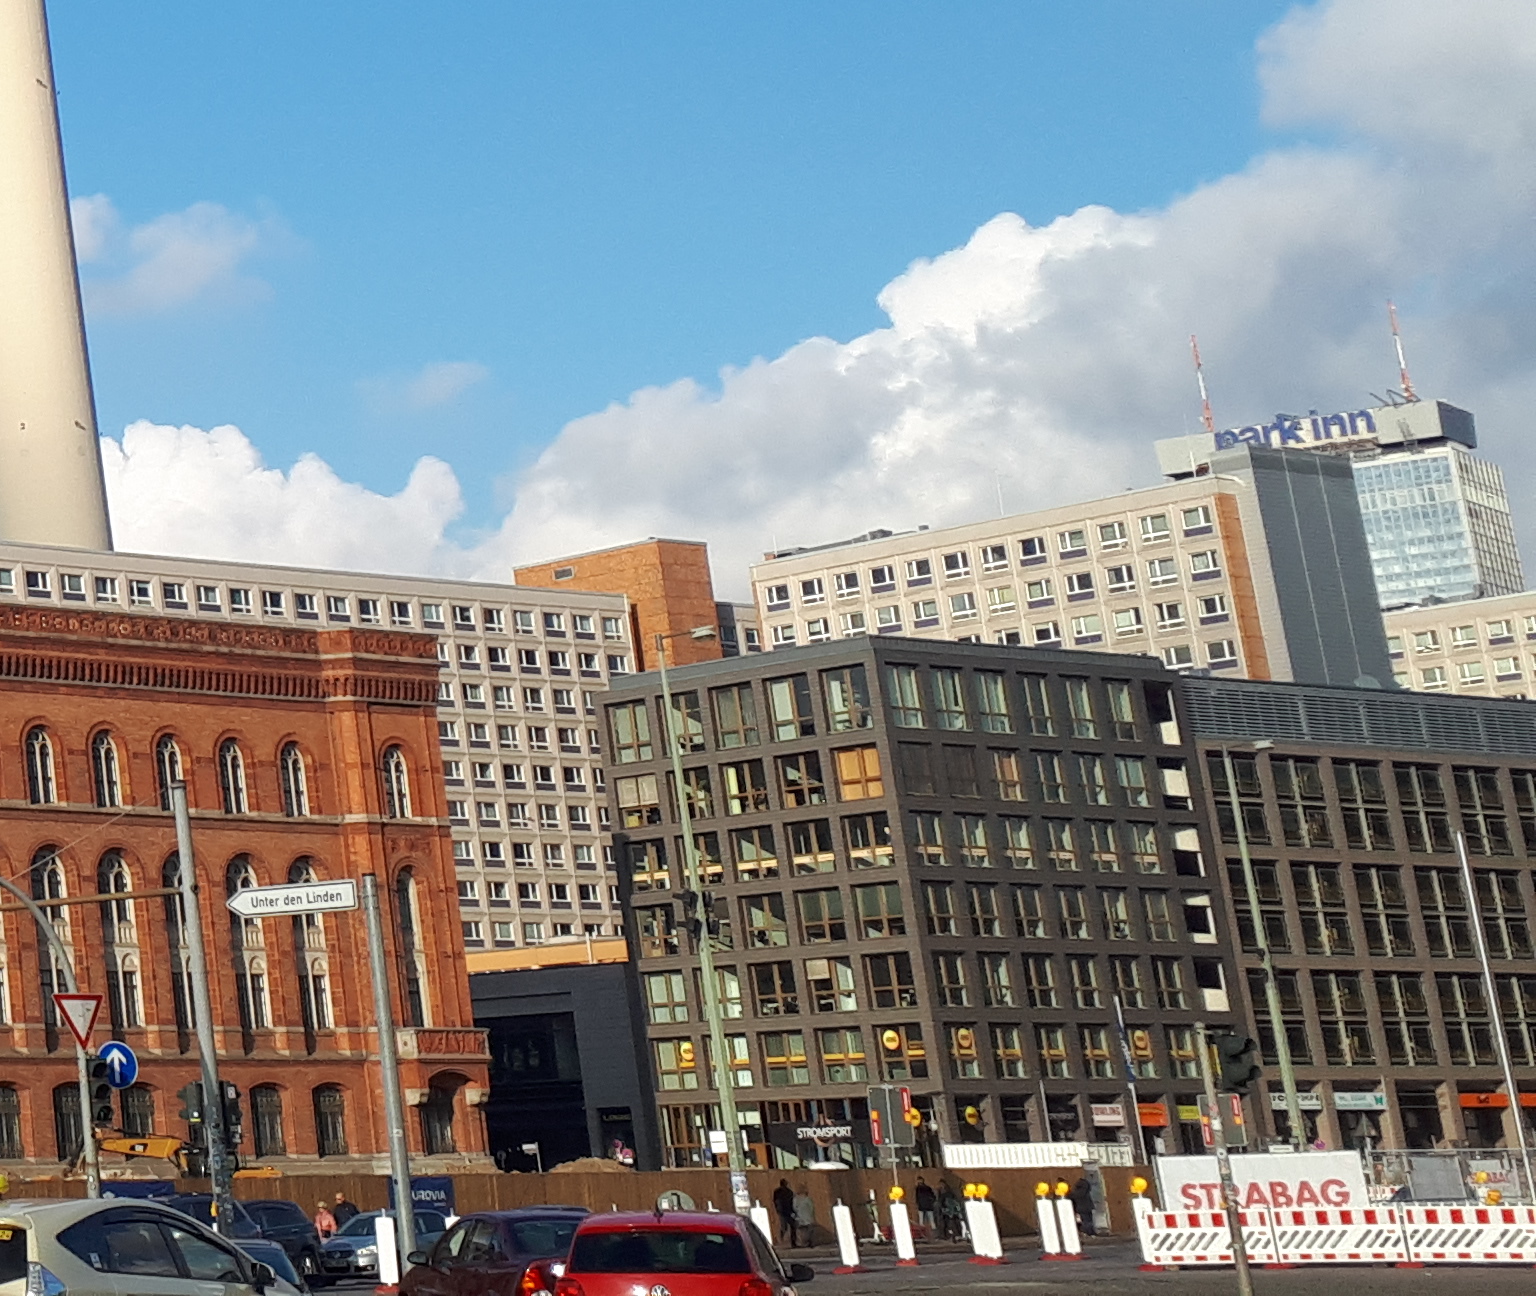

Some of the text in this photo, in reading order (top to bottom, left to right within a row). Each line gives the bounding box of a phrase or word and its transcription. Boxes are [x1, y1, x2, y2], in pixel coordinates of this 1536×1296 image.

[1215, 409, 1377, 450] park inn
[250, 892, 342, 908] Unter den Linden
[796, 1126, 852, 1139] STROMSPORT
[411, 1189, 447, 1201] UROVIA
